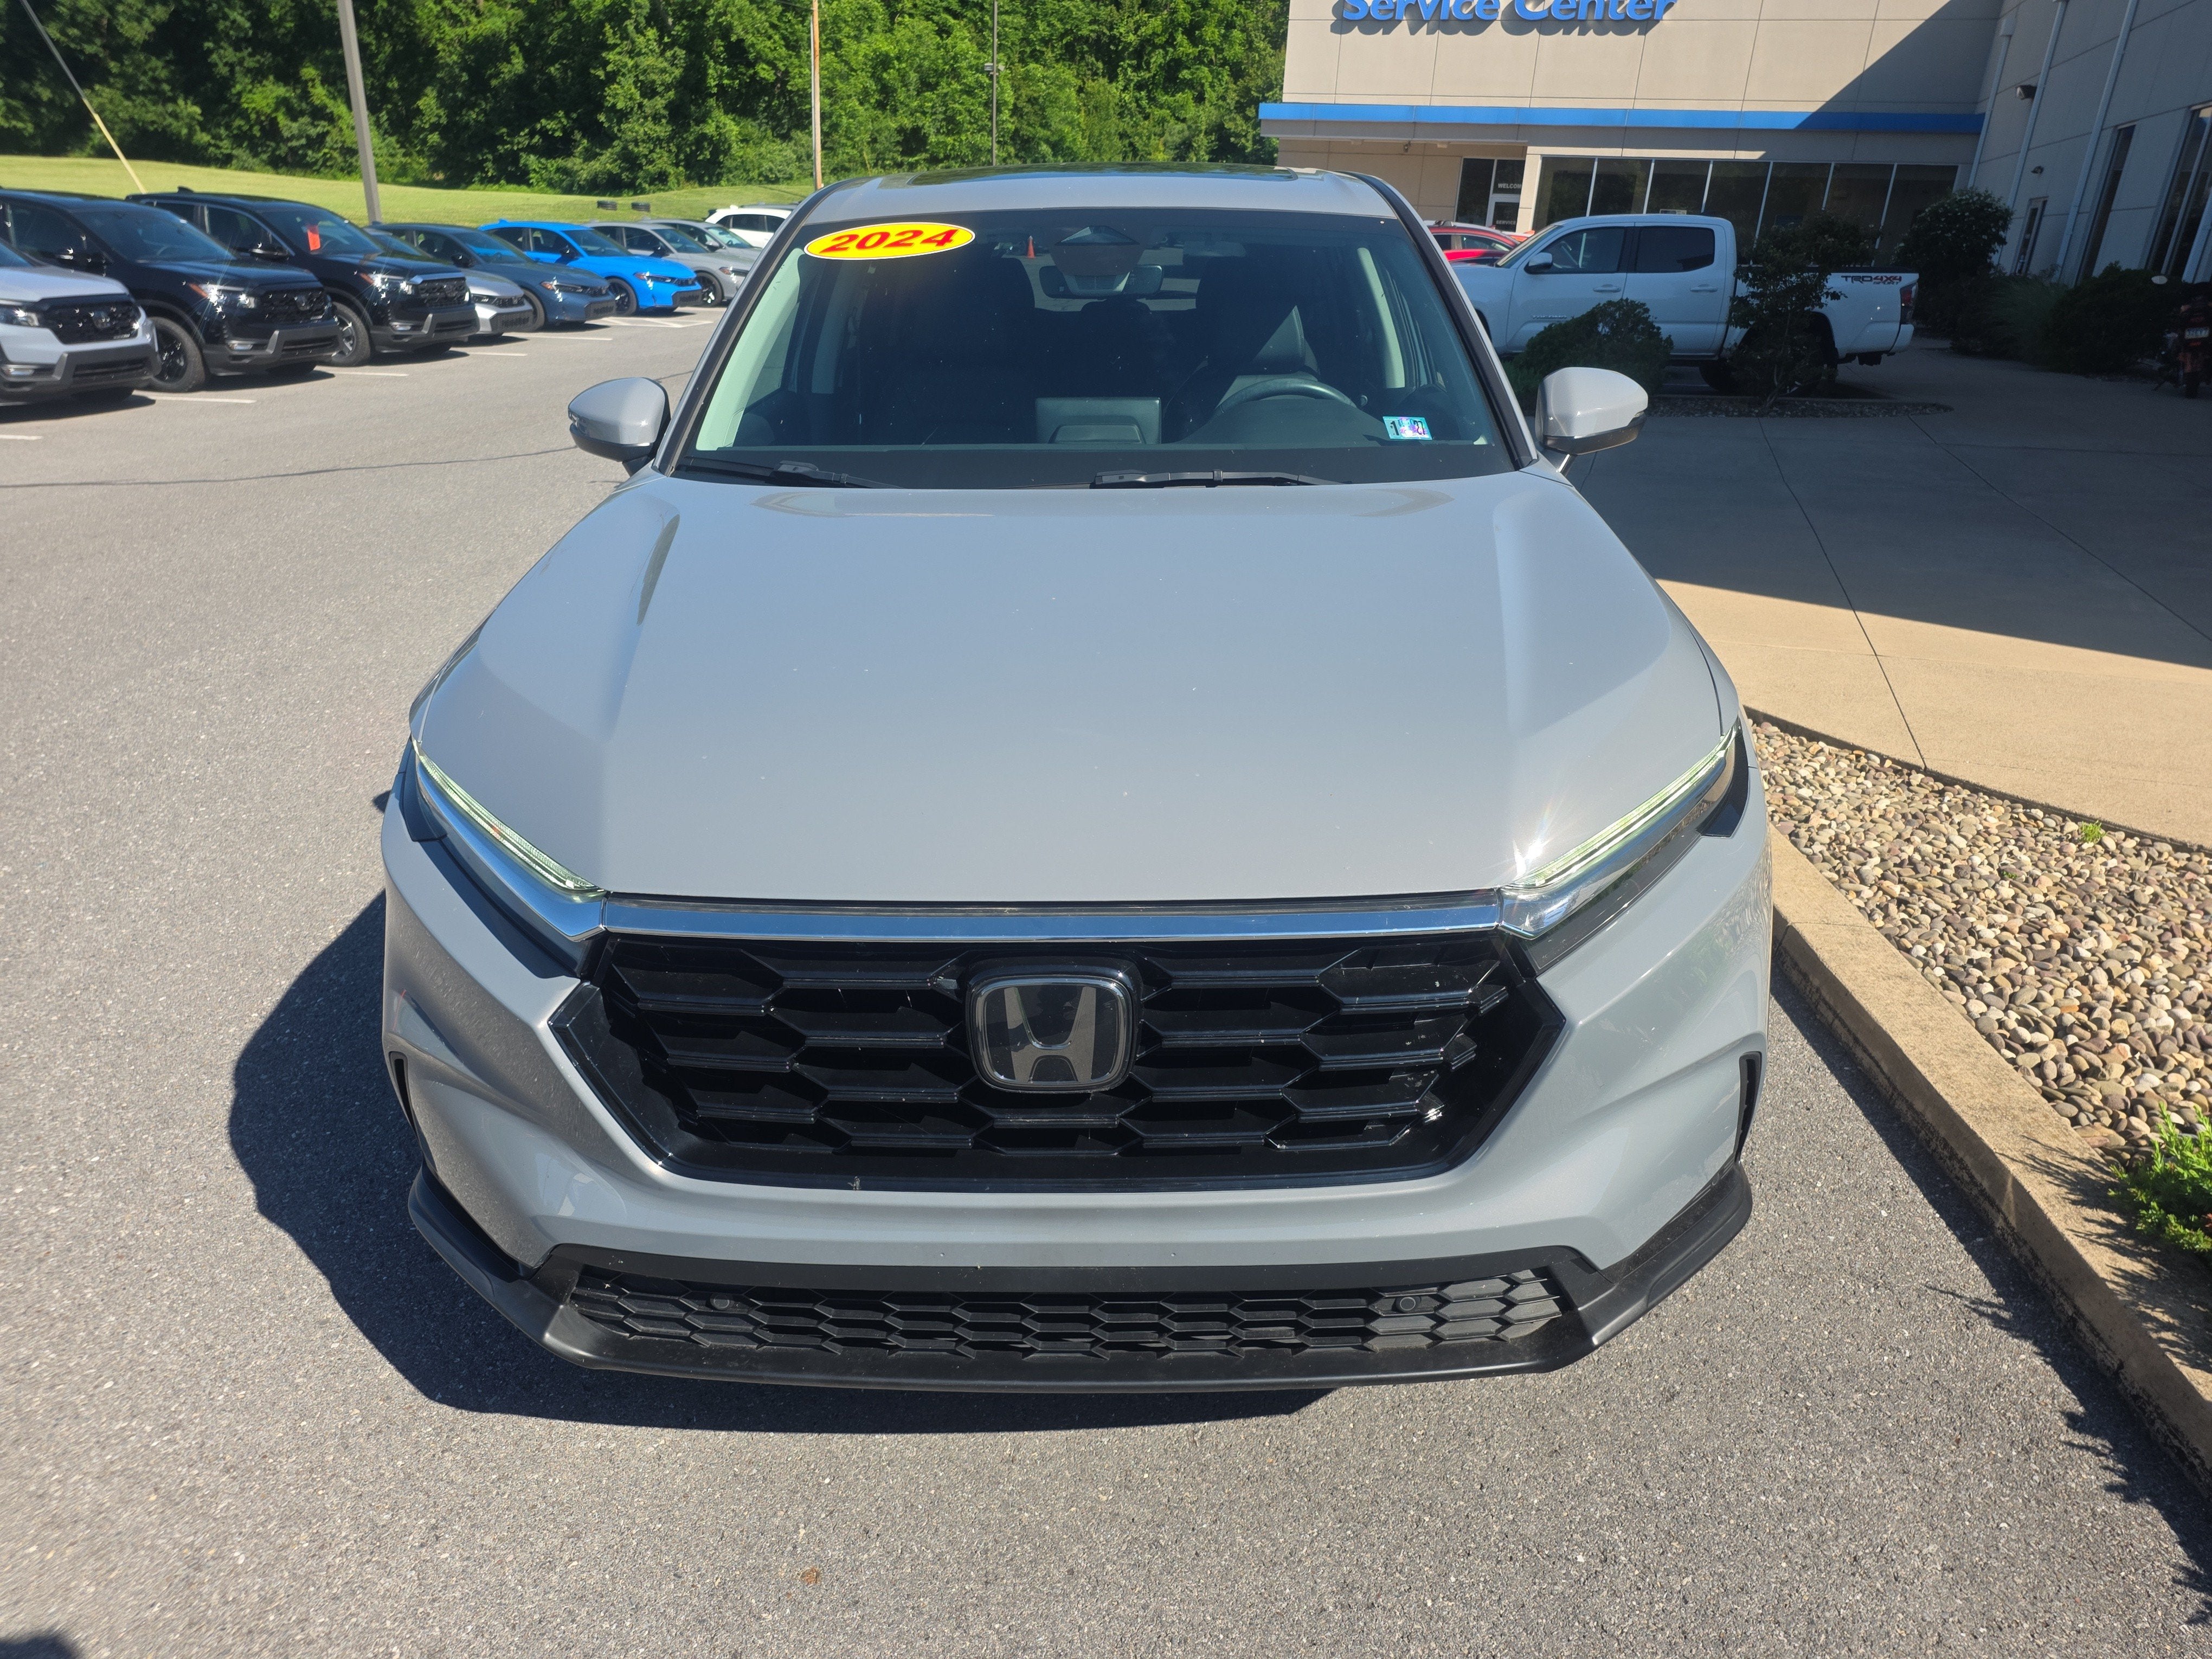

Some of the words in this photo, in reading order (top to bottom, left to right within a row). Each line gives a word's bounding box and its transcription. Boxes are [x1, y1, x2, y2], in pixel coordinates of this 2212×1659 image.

[1342, 0, 1500, 20] Service
[1514, 0, 1679, 20] Center
[818, 228, 960, 254] 2024
